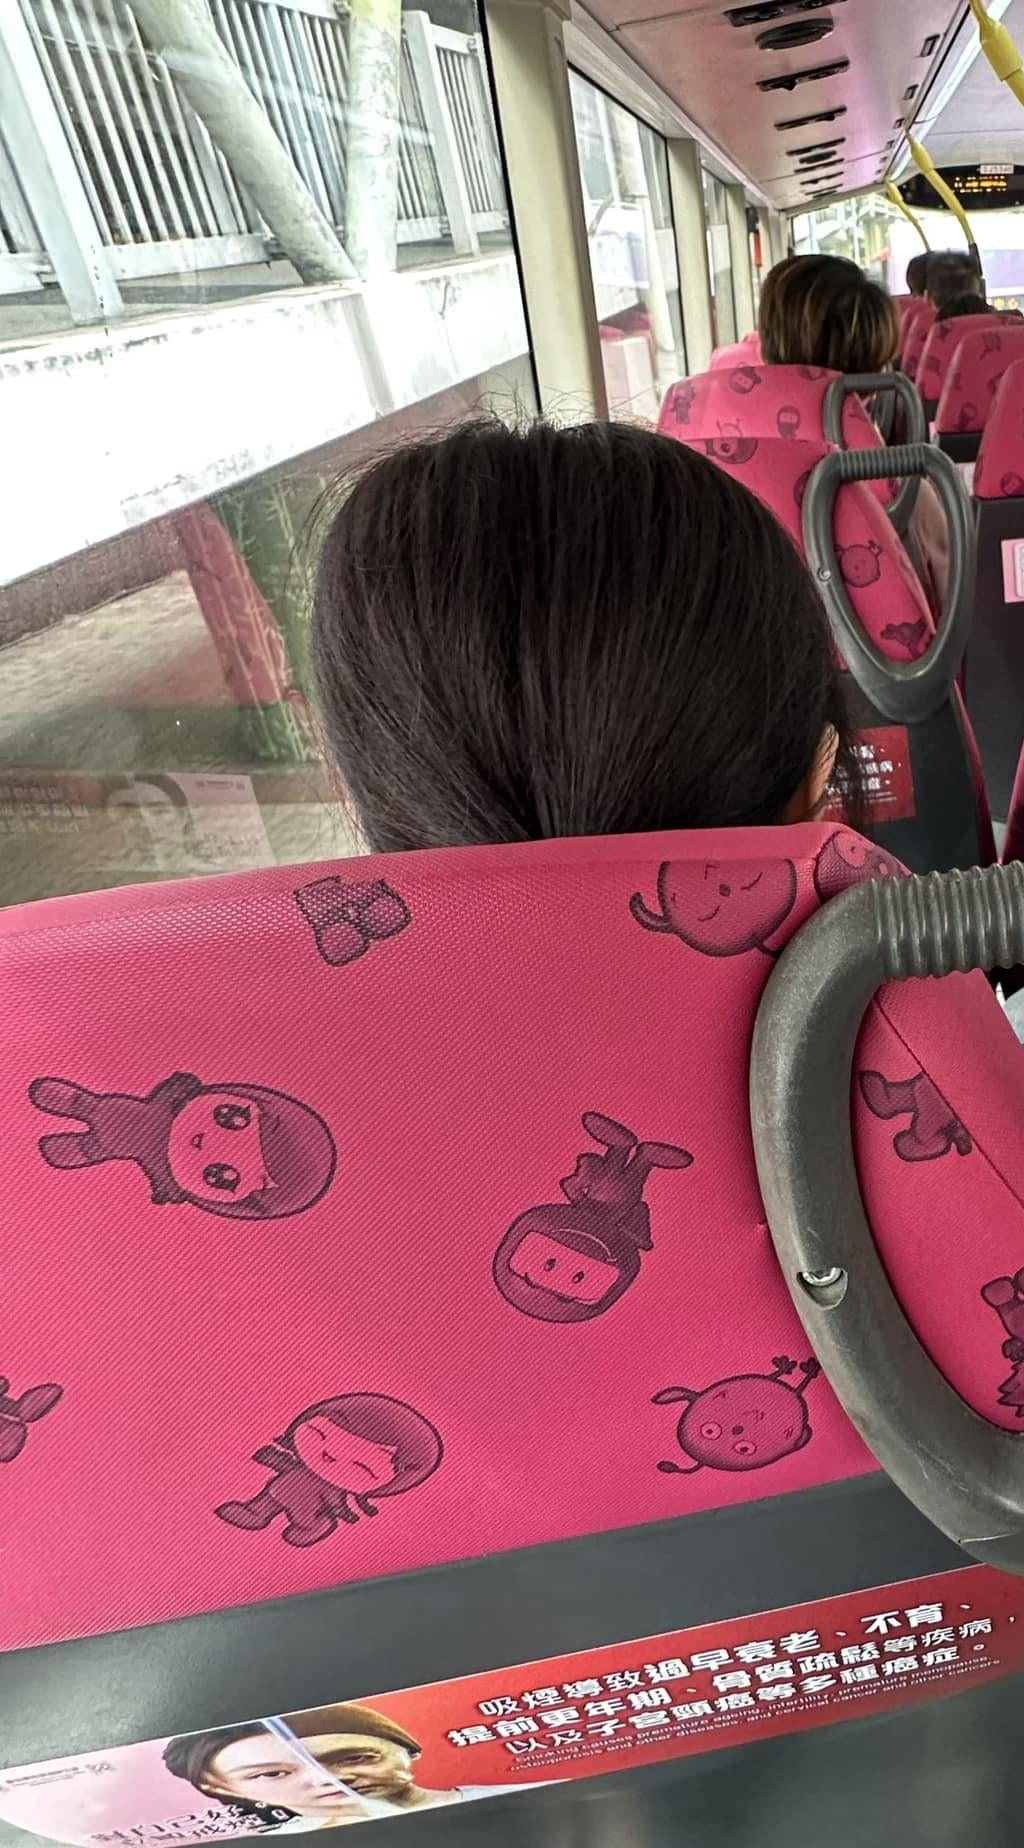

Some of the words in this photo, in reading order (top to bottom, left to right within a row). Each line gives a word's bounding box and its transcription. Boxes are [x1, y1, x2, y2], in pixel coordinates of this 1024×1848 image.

[606, 1741, 633, 1752] and
[636, 1733, 671, 1746] other
[747, 1712, 772, 1723] and
[636, 1717, 709, 1740] premature
